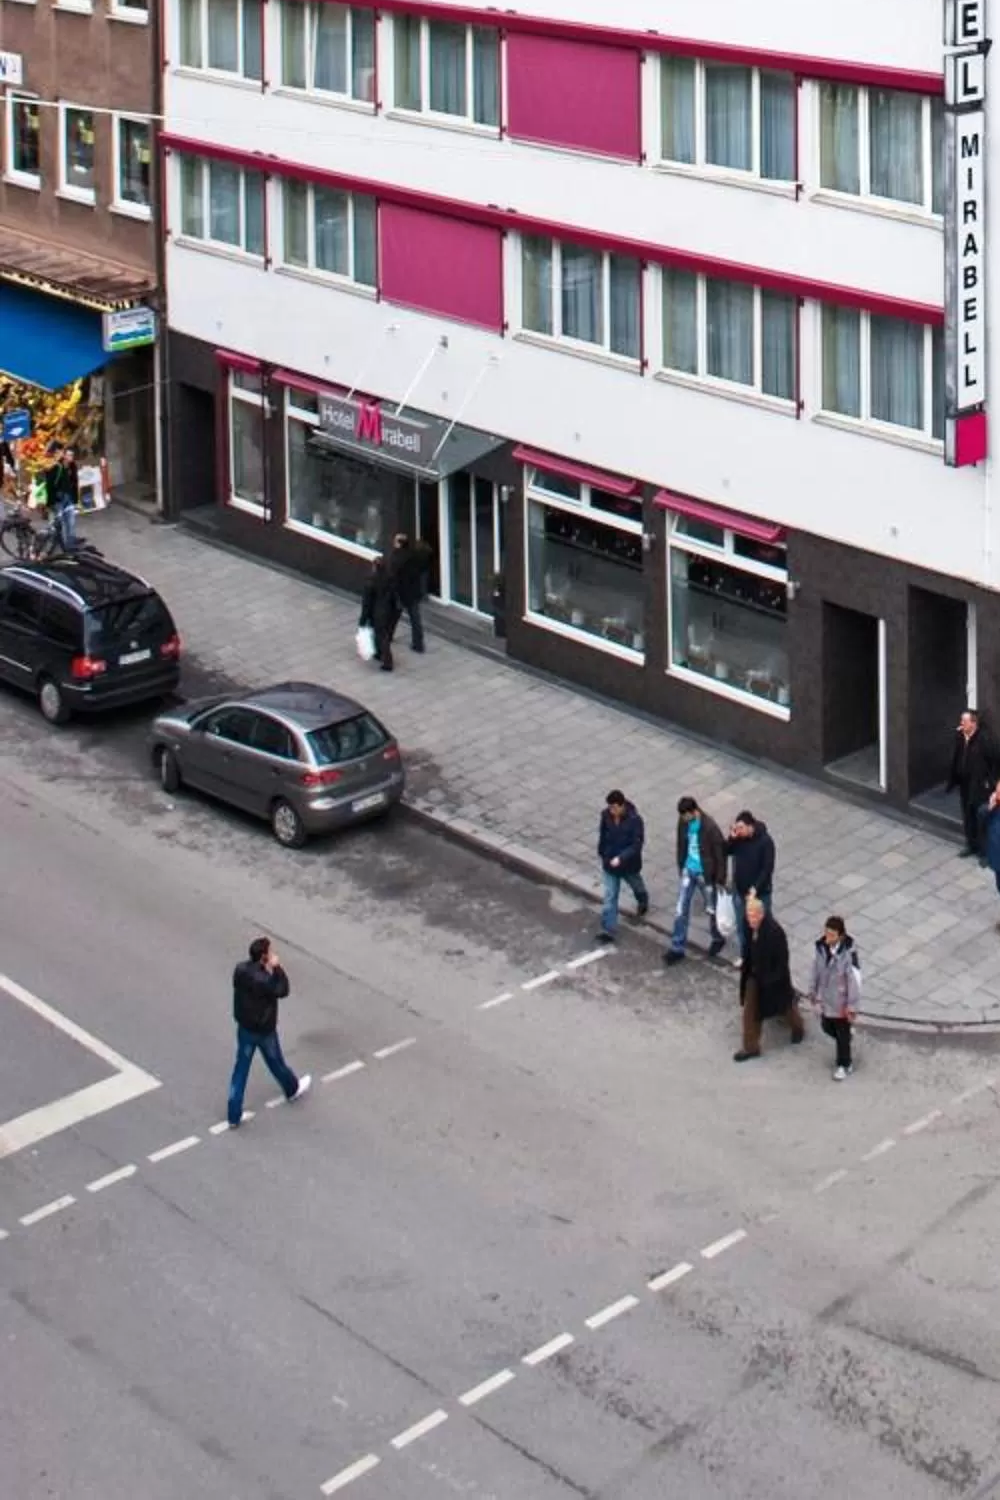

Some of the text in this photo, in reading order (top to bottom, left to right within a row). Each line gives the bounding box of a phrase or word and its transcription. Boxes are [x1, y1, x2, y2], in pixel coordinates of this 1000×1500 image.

[961, 133, 979, 387] MIRABELL
[322, 399, 420, 453] Hotel Mirabell
